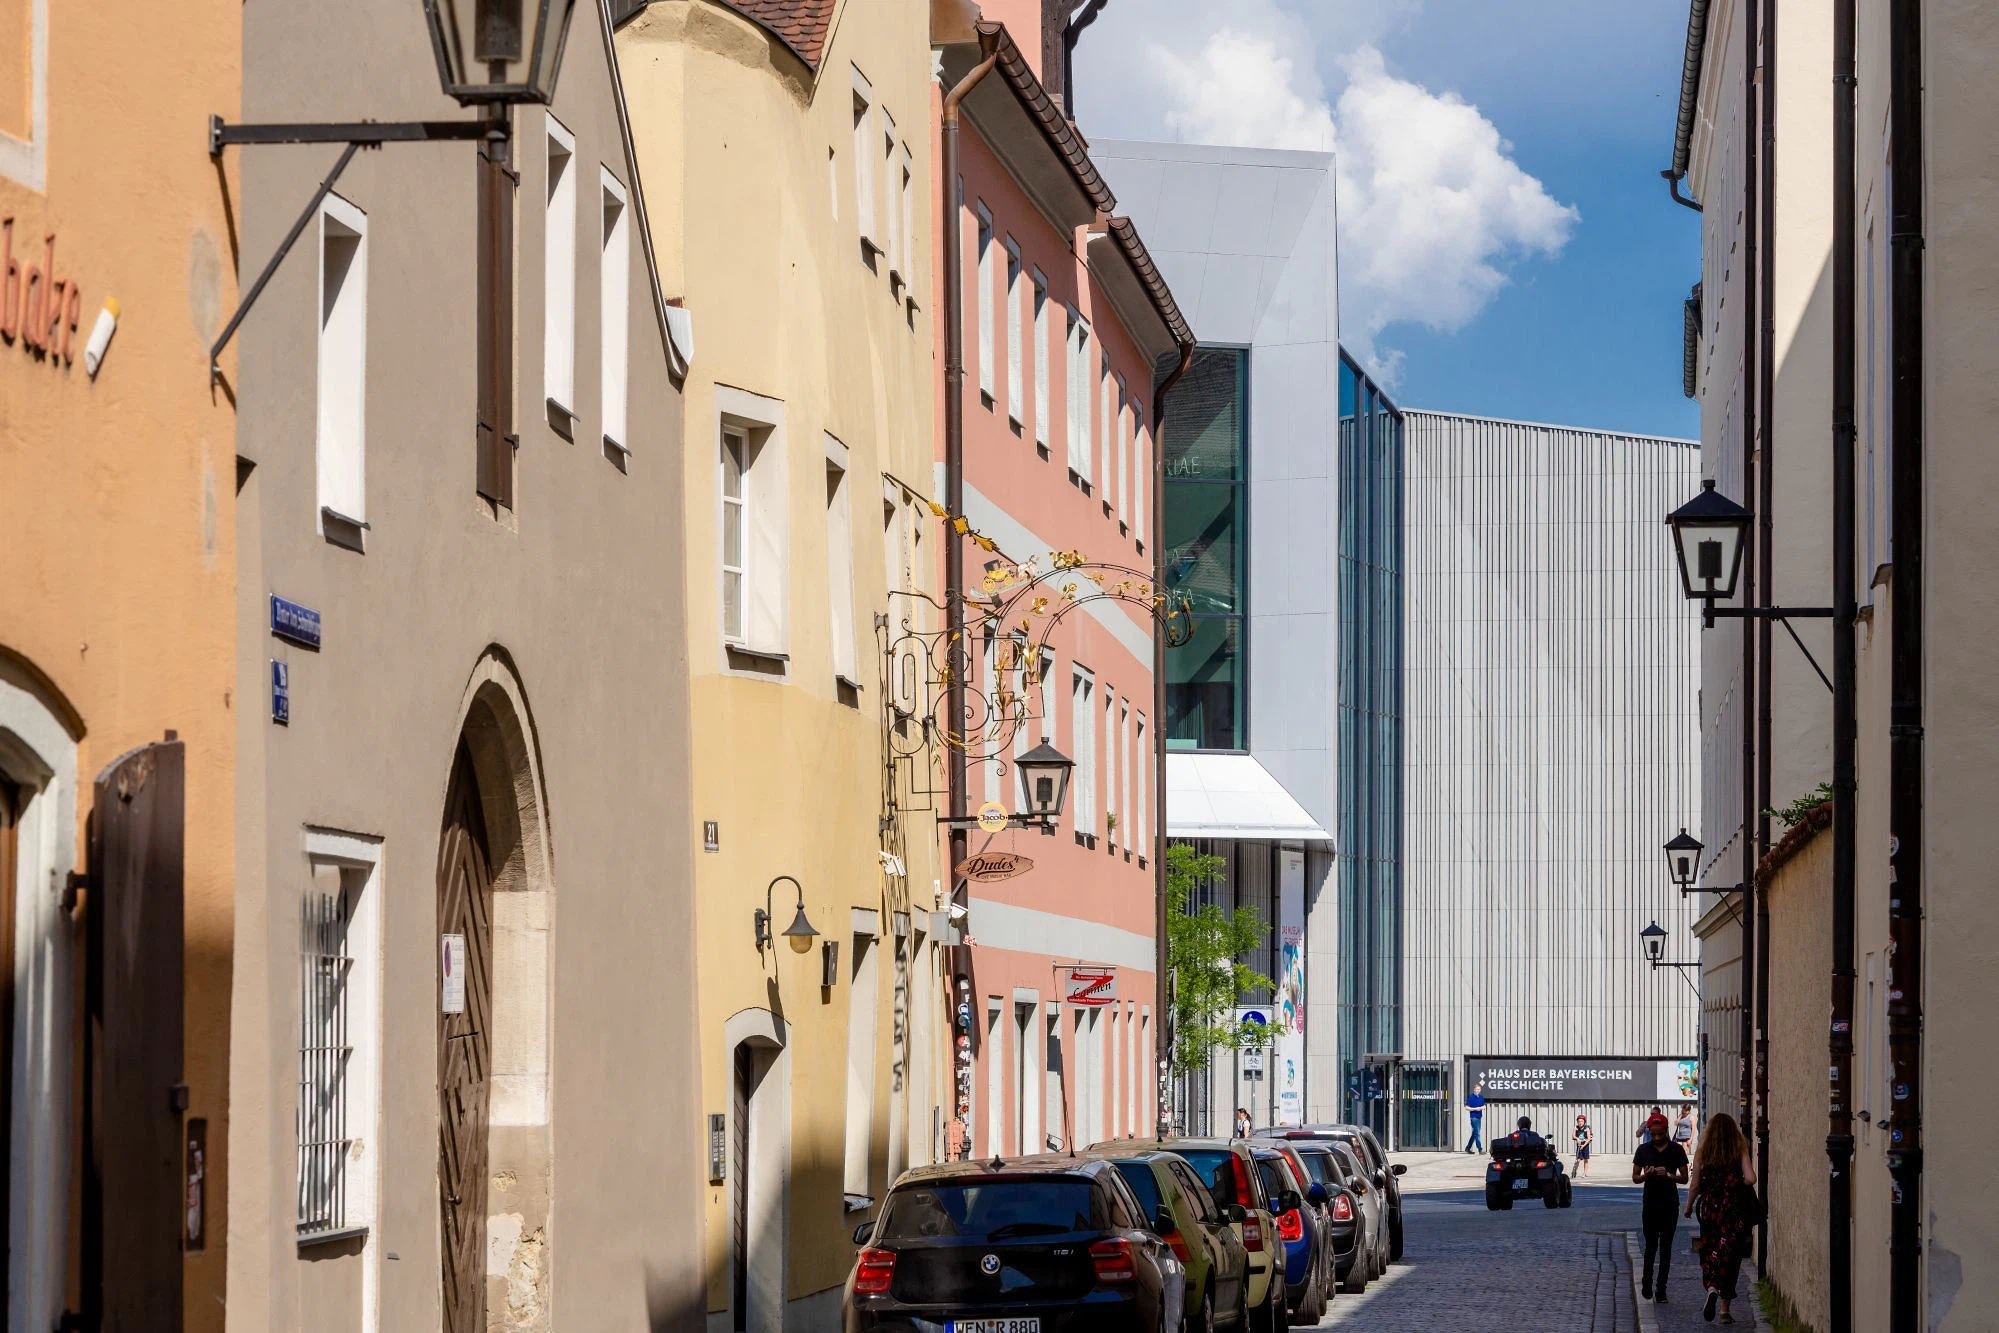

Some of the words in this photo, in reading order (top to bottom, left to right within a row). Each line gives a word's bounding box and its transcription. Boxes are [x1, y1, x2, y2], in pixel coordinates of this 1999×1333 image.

[980, 813, 1005, 822] Jacob
[707, 823, 715, 843] 21
[1488, 1069, 1520, 1079] HAUS
[1523, 1069, 1546, 1079] DER
[1550, 1069, 1632, 1080] BAYERISCHEN
[1488, 1080, 1563, 1090] GESCHICHTE
